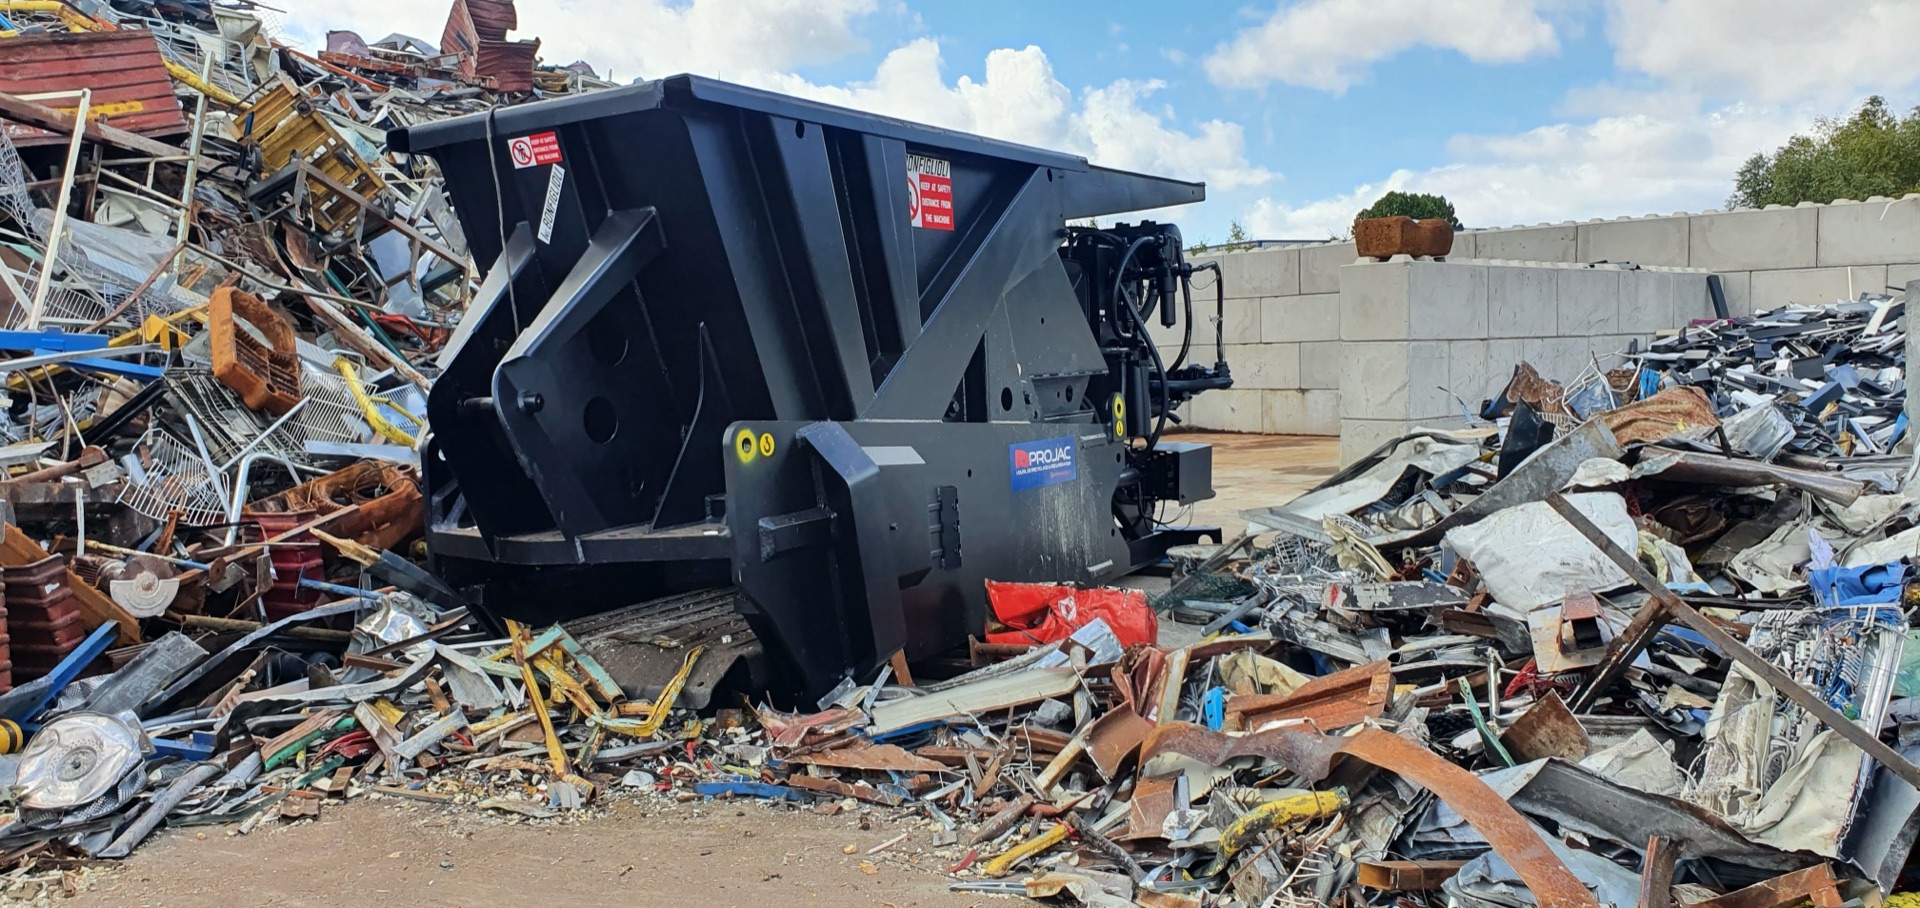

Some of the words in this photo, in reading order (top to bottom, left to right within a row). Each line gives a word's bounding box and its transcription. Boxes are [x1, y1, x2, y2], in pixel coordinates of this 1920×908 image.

[920, 181, 930, 191] KEEP
[931, 183, 936, 191] AT
[937, 184, 951, 193] SAFETY
[543, 166, 563, 230] BONFIGLIOLI
[922, 198, 940, 208] DISTANCE
[940, 200, 951, 209] FROM
[925, 213, 933, 222] THE
[934, 215, 950, 224] MACHINE
[1029, 446, 1071, 466] PROJAC
